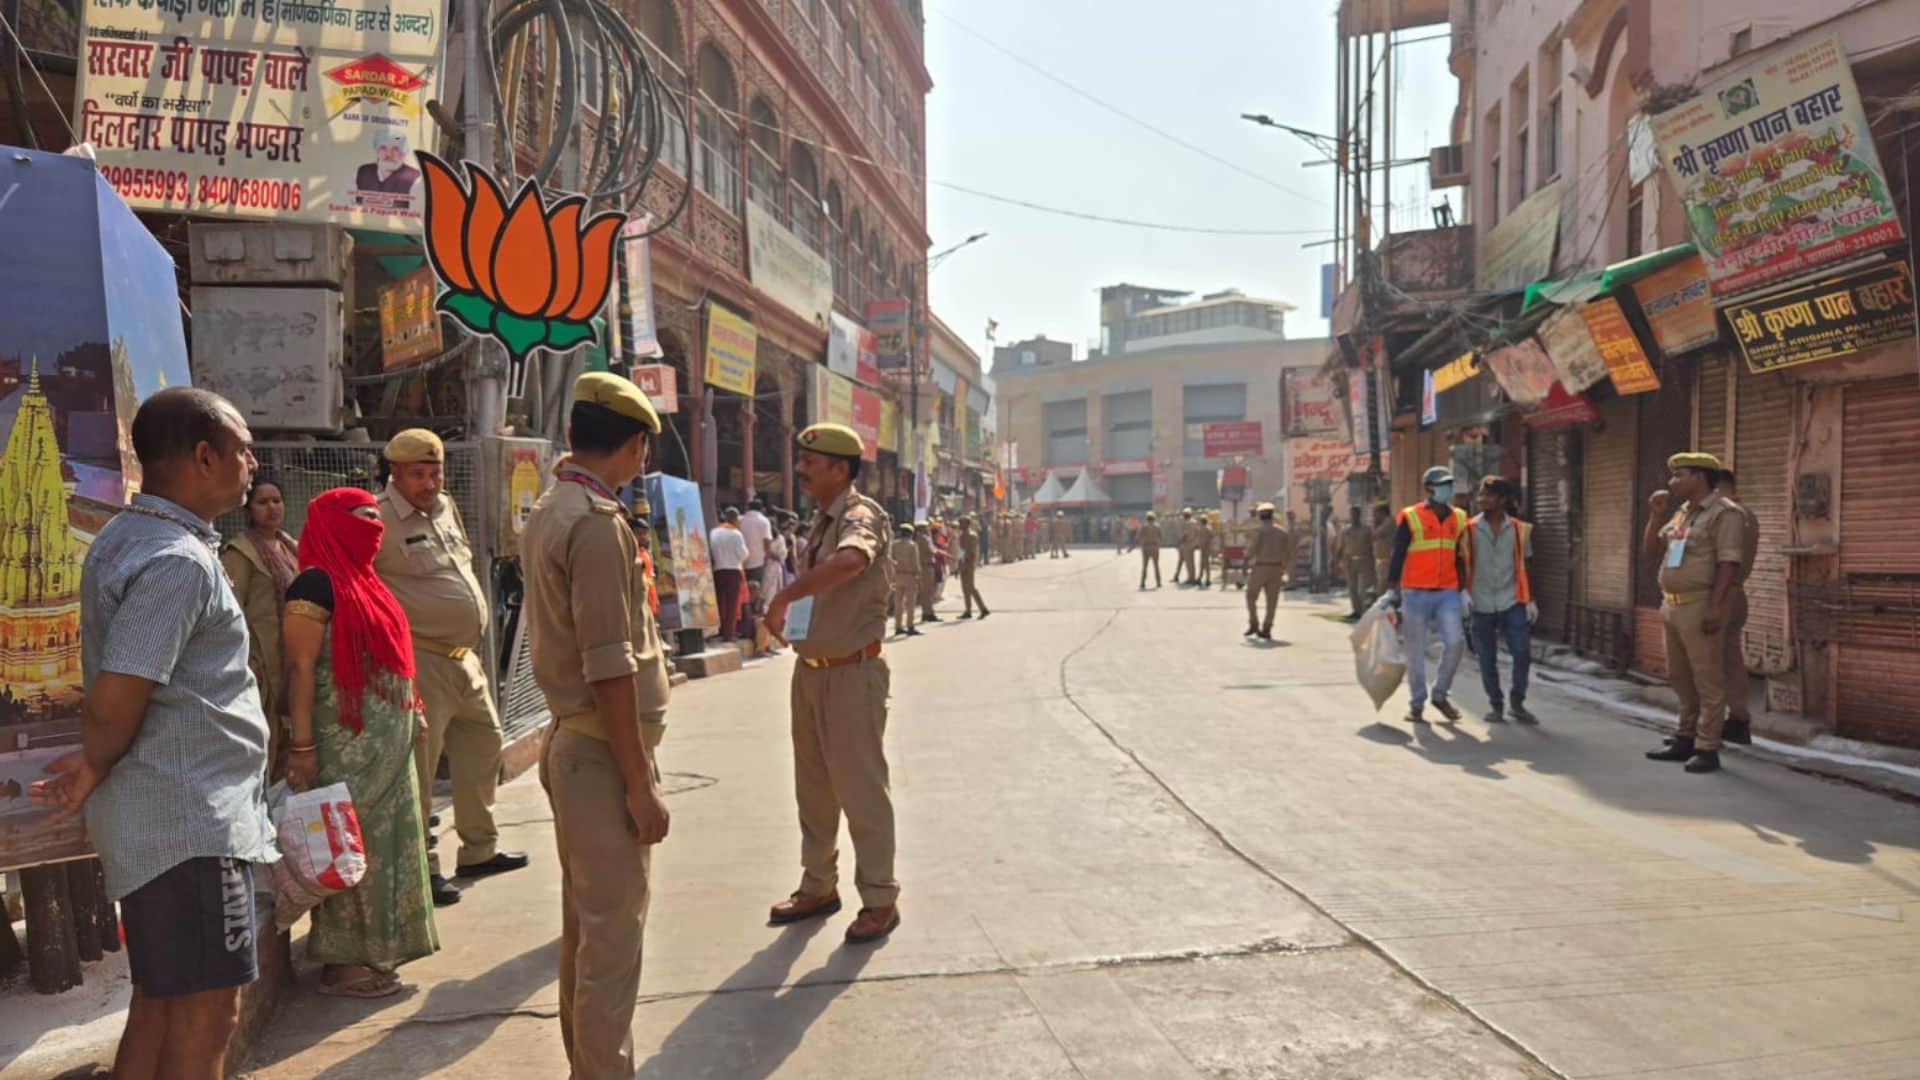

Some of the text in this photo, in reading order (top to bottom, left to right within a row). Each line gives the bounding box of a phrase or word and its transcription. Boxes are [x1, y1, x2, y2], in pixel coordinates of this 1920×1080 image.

[378, 5, 391, 31] से
[87, 36, 311, 96] सरदार जी पापड़ वाले
[344, 67, 396, 86] SARDAR
[142, 96, 160, 110] का
[342, 86, 376, 97] PAPAD
[81, 99, 305, 166] दिलदार पापड़ भण्डार
[1673, 143, 1700, 178] श्री
[1698, 125, 1750, 175] कृष्णा
[1748, 106, 1792, 144] पान
[1791, 84, 1844, 125] बहार
[199, 175, 301, 211] 8400680006
[1735, 276, 1912, 343] श्री कृष्णा पान बहार
[1789, 328, 1844, 346] KRISHNA
